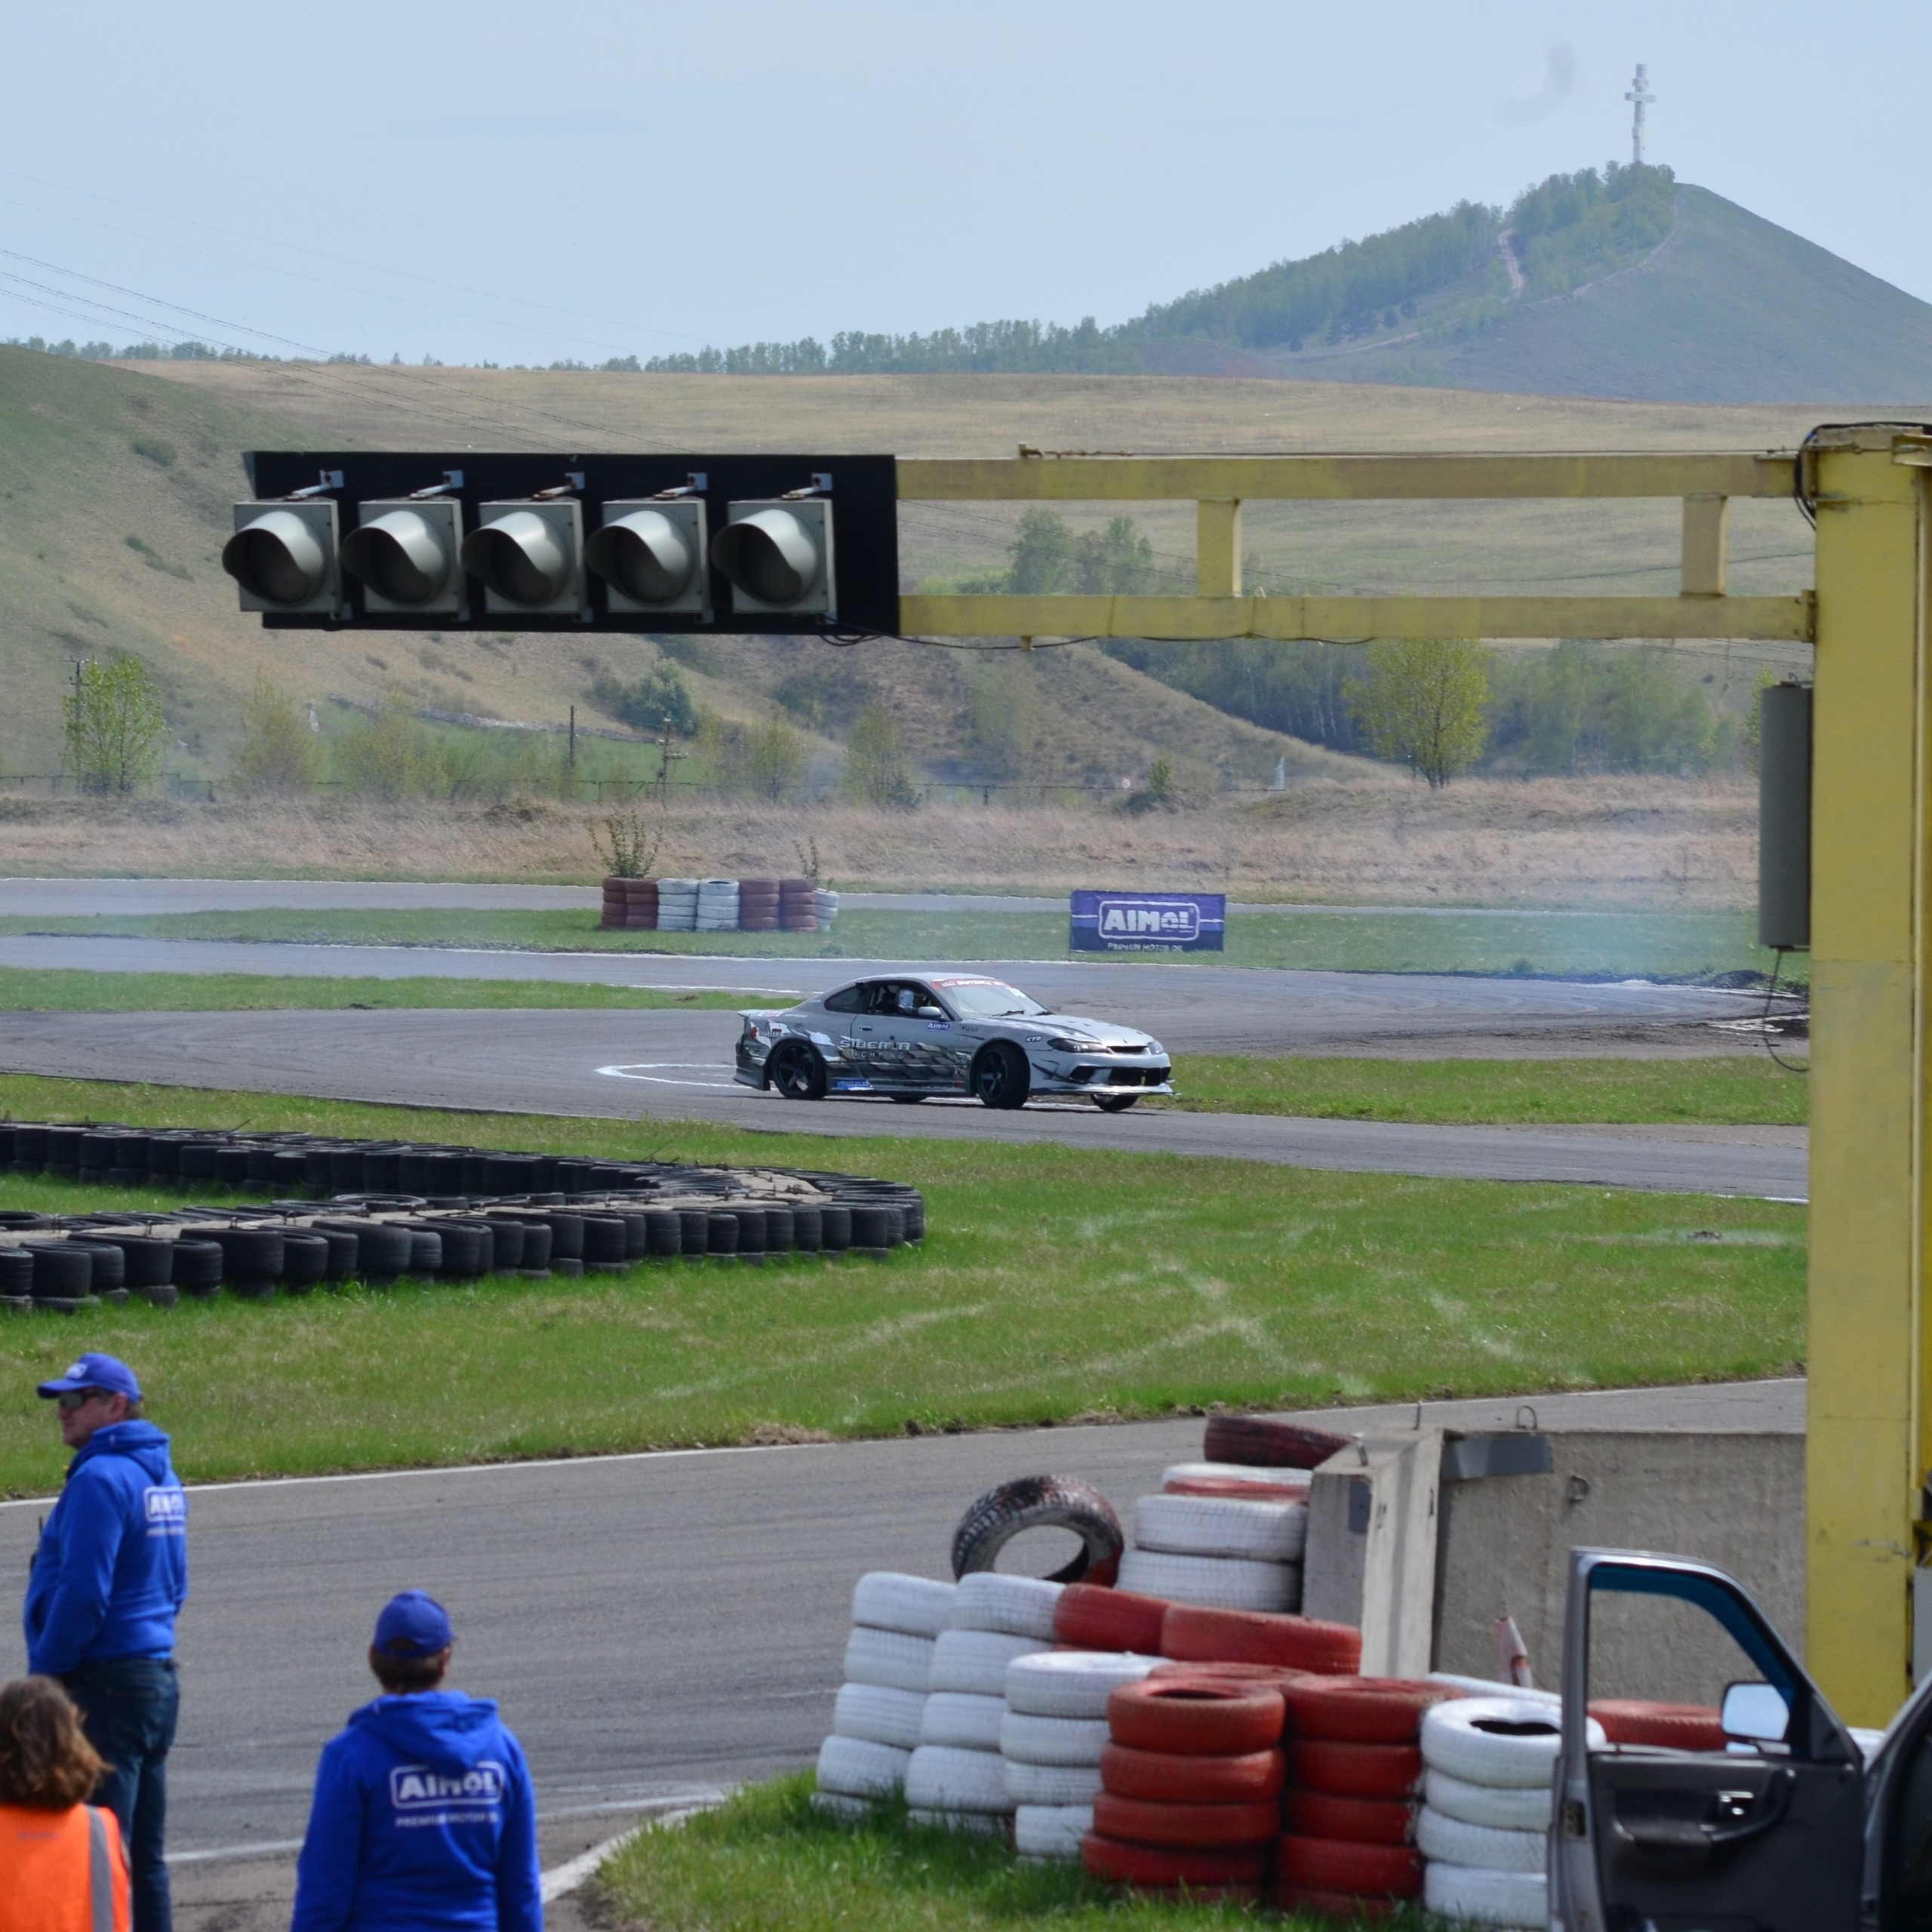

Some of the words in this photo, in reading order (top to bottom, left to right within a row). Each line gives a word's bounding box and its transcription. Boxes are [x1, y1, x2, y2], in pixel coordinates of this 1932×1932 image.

[1103, 909, 1194, 933] AIMOL
[1107, 943, 1140, 951] PREMIUM
[840, 1039, 911, 1051] SIBERIA
[398, 1771, 498, 1801] AIMOL
